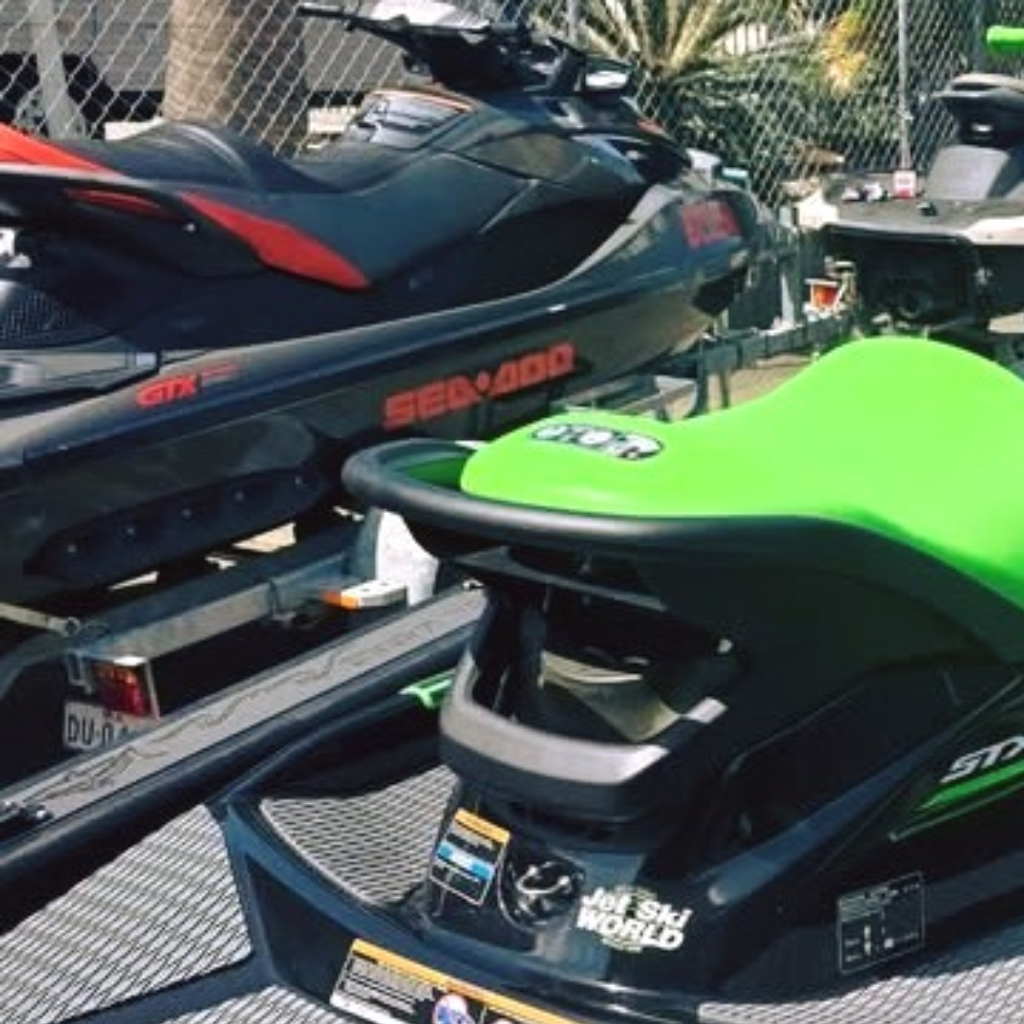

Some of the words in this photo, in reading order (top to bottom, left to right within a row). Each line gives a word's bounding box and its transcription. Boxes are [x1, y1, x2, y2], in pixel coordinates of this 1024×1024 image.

[137, 373, 196, 408] GTX
[576, 905, 685, 951] WORLD
[582, 886, 632, 915] Jet
[636, 899, 693, 929] Ski
